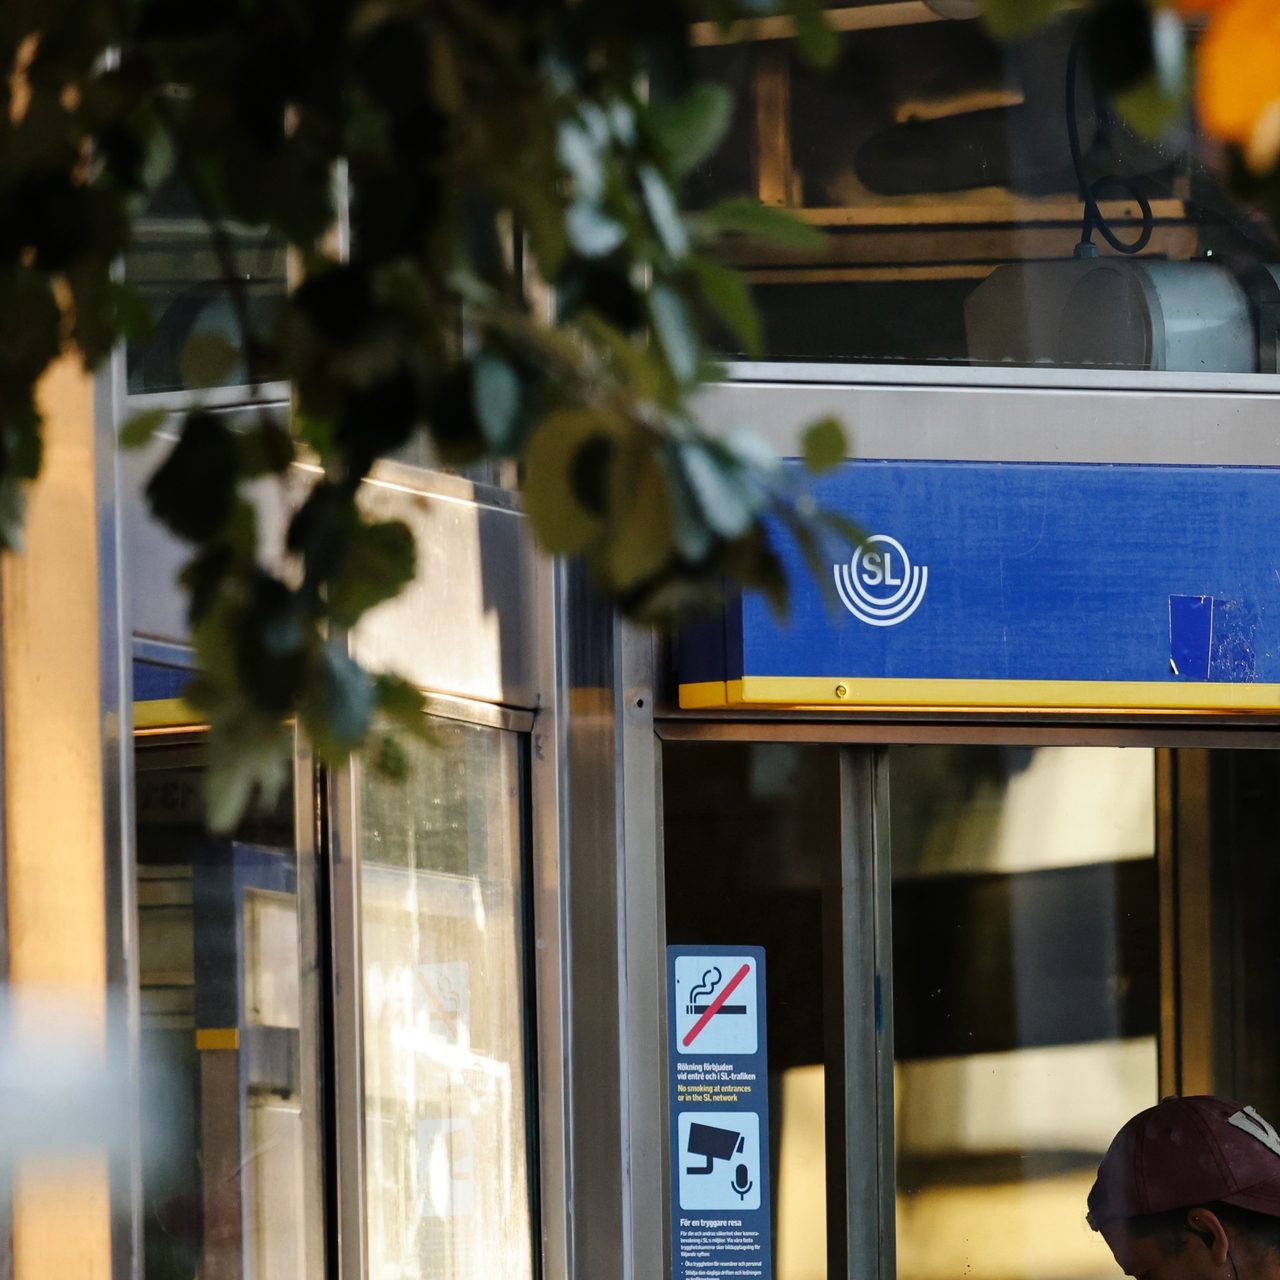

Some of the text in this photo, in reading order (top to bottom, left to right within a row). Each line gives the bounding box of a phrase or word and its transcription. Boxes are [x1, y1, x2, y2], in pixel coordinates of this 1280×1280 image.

[861, 552, 901, 586] SL
[677, 1062, 733, 1072] Rökning förbjuden
[677, 1071, 686, 1081] vid
[687, 1071, 704, 1081] entré
[705, 1071, 717, 1081] och
[720, 1071, 756, 1081] SL-trafiken
[677, 1084, 751, 1094] No smoking at entrances
[680, 1218, 742, 1228] För en tryggare resa
